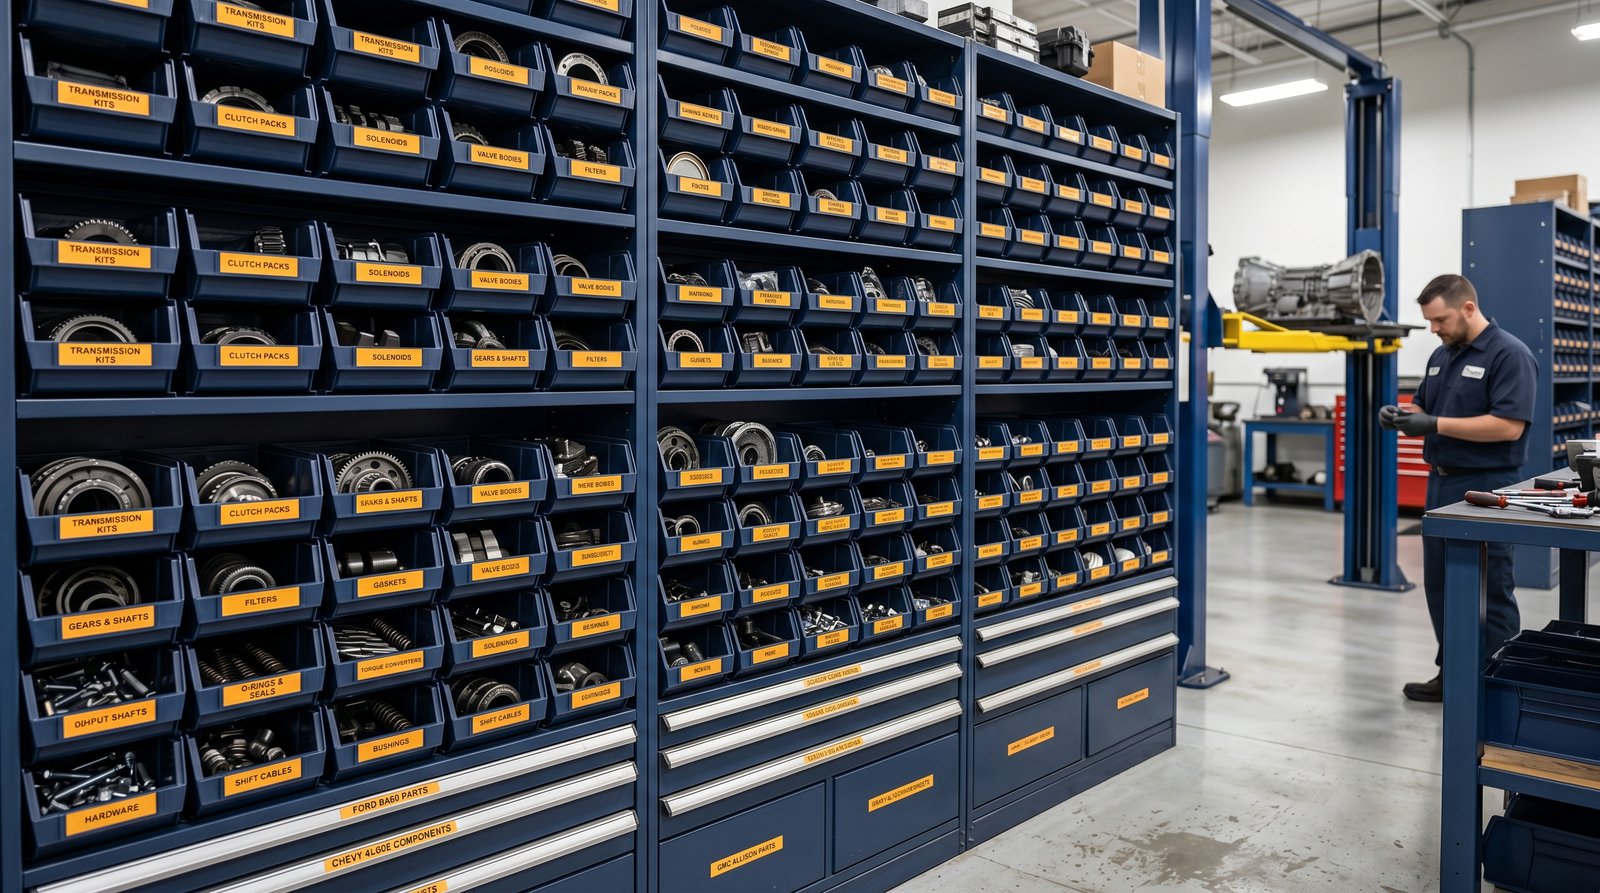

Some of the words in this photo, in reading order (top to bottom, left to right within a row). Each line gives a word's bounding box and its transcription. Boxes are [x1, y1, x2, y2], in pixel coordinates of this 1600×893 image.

[225, 7, 286, 26] TRANSMISSION
[247, 20, 265, 29] KITS
[360, 35, 413, 52] TRANSMISSION
[378, 47, 394, 55] KITS
[68, 85, 139, 103] TRANSMISSION
[599, 89, 617, 98] PACKS
[94, 99, 115, 108] KITS
[225, 113, 258, 124] CLUTCH
[260, 118, 287, 129] PACKS
[366, 134, 408, 147] SOLENOIDS
[477, 150, 498, 160] VALVE
[499, 154, 522, 163] BODIES
[584, 166, 607, 176] FILTERS
[69, 245, 140, 256] TRANSMISSION
[95, 256, 116, 264] KITS
[227, 259, 261, 268] CLUTCH
[263, 262, 290, 270] PACKS
[369, 269, 410, 278] SOLENOIDS
[70, 347, 140, 355] TRANSMISSION
[96, 356, 116, 364] KITS
[480, 489, 499, 497] VALVE
[391, 495, 418, 504] SHAFTS
[229, 508, 262, 517] CLUTCH
[264, 505, 290, 514] PACKS
[97, 525, 118, 533] KITS
[481, 565, 500, 574] VALVE
[245, 595, 277, 606] FILTERS
[68, 619, 102, 630] GEARS
[104, 618, 110, 626] &
[113, 613, 149, 624] SHAFTS
[361, 664, 384, 673] TORQUE
[385, 657, 422, 668] CONVERTERS
[250, 688, 276, 699] SEALS
[112, 708, 147, 721] SHAFTS
[480, 716, 497, 726] SHIFT
[498, 710, 522, 721] CABLES
[373, 738, 409, 752] BUSHINGS
[235, 774, 258, 787] SHIFT
[260, 766, 292, 780] CABLES
[353, 801, 377, 814] FORD
[401, 786, 428, 800] PARTS
[85, 803, 139, 824] HARDWARE
[332, 851, 362, 867] CHEVY
[393, 824, 451, 848] COMPONENTS
[717, 860, 731, 871] GMC
[732, 850, 757, 865] ALLISON
[758, 842, 776, 854] PARTS
